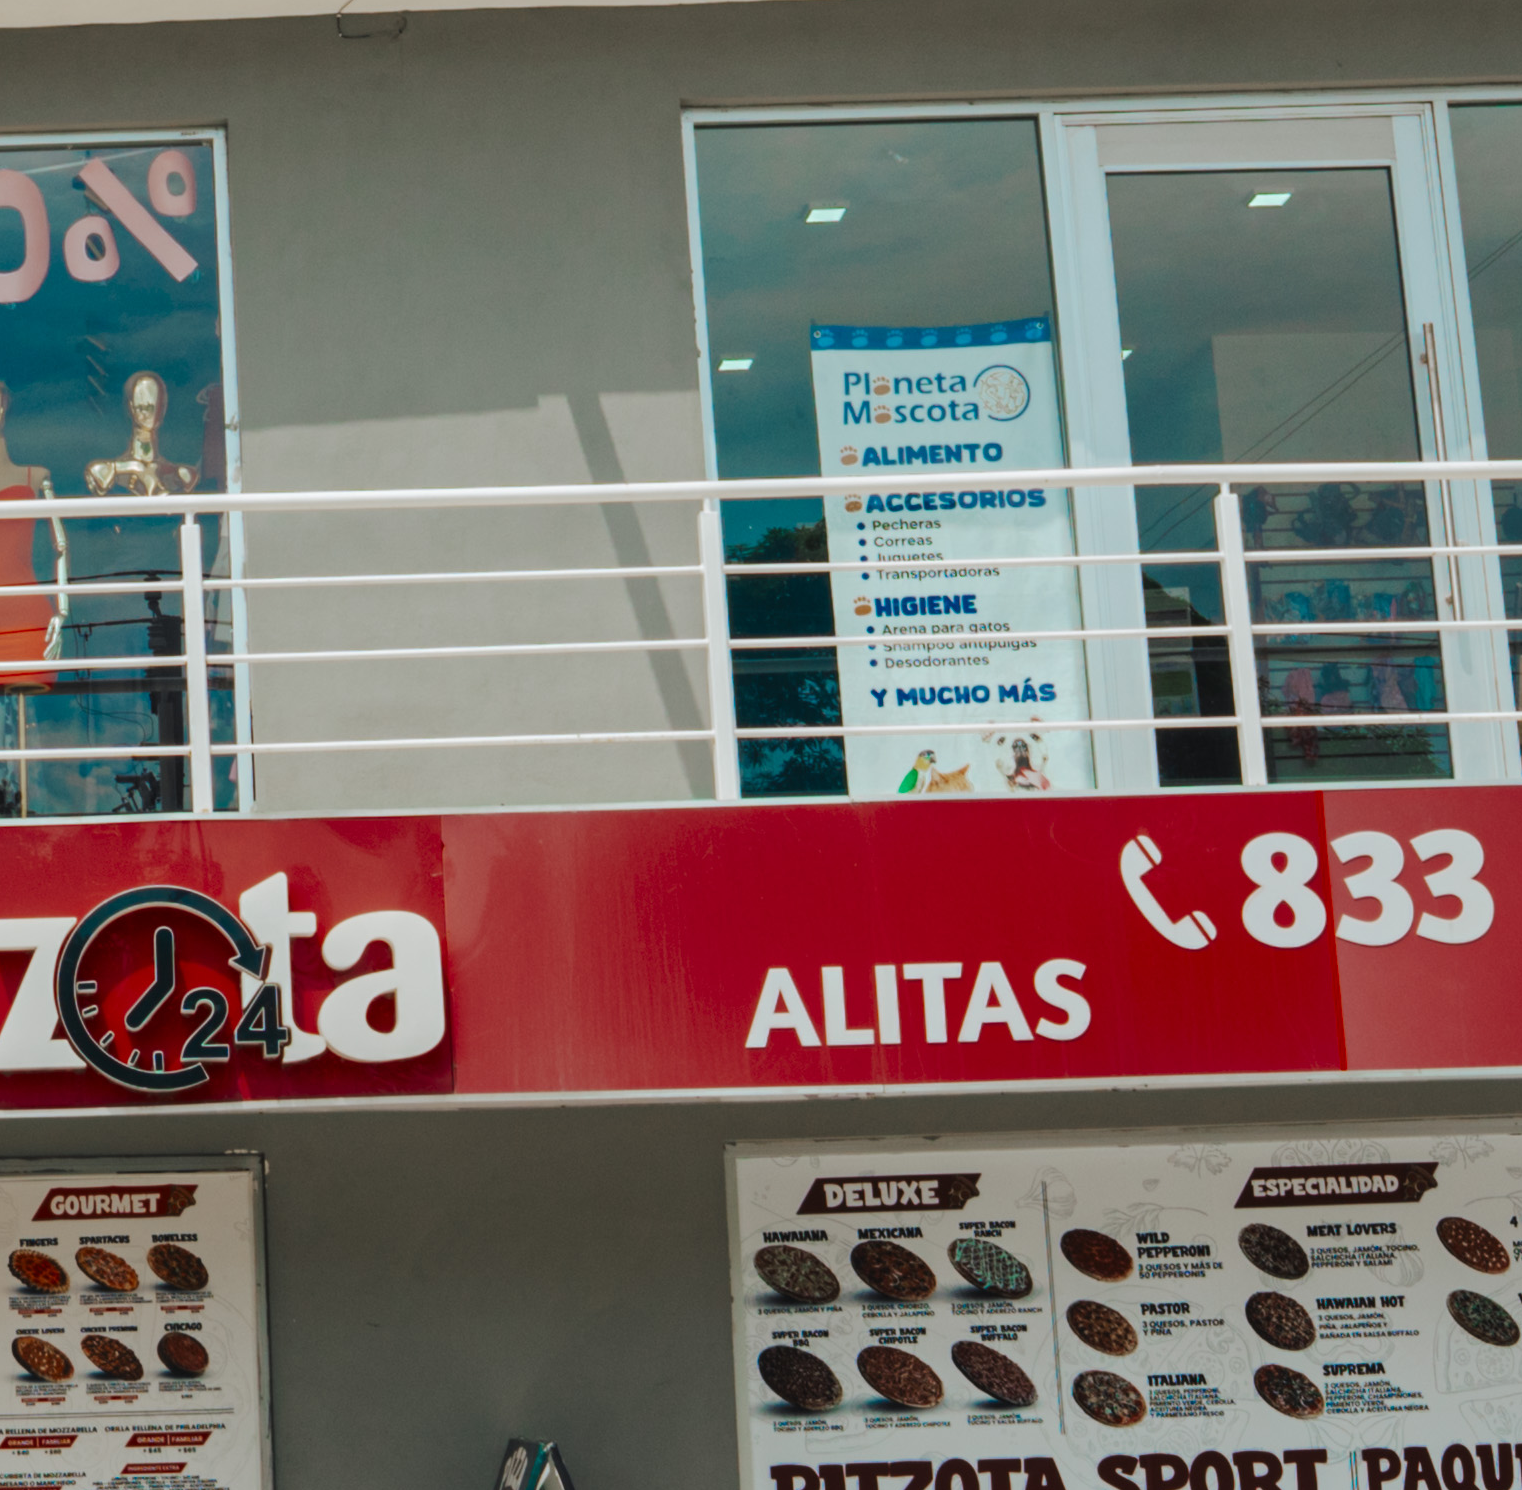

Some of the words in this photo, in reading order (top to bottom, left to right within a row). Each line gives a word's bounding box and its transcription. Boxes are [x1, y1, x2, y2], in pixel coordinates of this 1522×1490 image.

[862, 442, 1003, 467] ALIMENTO
[865, 488, 1047, 514] ACCESORIOS
[872, 517, 942, 532] Pecheras
[873, 535, 933, 548] Correas
[876, 566, 1001, 582] Transportadoras
[874, 594, 978, 617] HIGIENE
[882, 623, 927, 635] Arena
[931, 623, 964, 635] para
[969, 621, 1011, 635] gatos
[885, 655, 990, 669] Desodorantes
[870, 688, 888, 707] Y
[895, 684, 990, 707] MUCHO
[998, 677, 1057, 704] MÁS
[1240, 828, 1495, 950] 833
[744, 958, 1092, 1049] ALITAS
[180, 981, 290, 1063] 24
[823, 1180, 940, 1208] DELUXE
[1251, 1174, 1399, 1198] ESPECIALIDAD
[50, 1193, 160, 1216] GOURMET
[1136, 1232, 1170, 1244] WILD
[1307, 1225, 1342, 1237] MEAT
[1347, 1223, 1397, 1236] LOVERS
[1137, 1245, 1211, 1259] PEPPERONI
